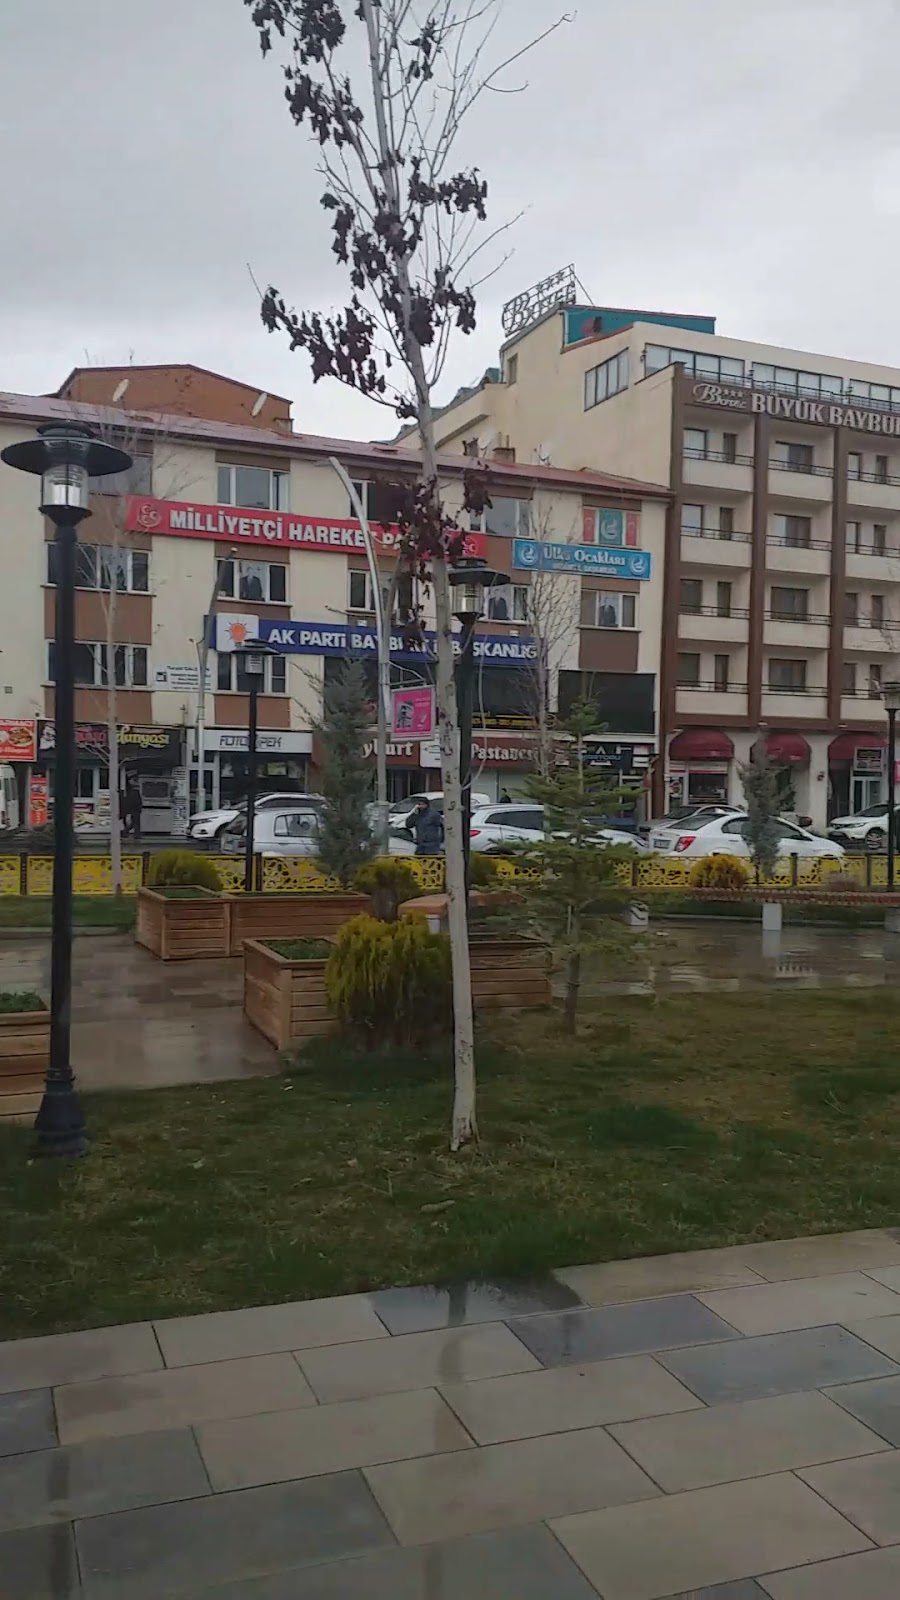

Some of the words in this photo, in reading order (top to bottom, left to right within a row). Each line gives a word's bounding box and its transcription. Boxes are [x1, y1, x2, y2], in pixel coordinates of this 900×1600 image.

[751, 390, 824, 424] BÜYÜK
[169, 506, 283, 541] MİLLİYETÇİ
[268, 628, 297, 645] AK
